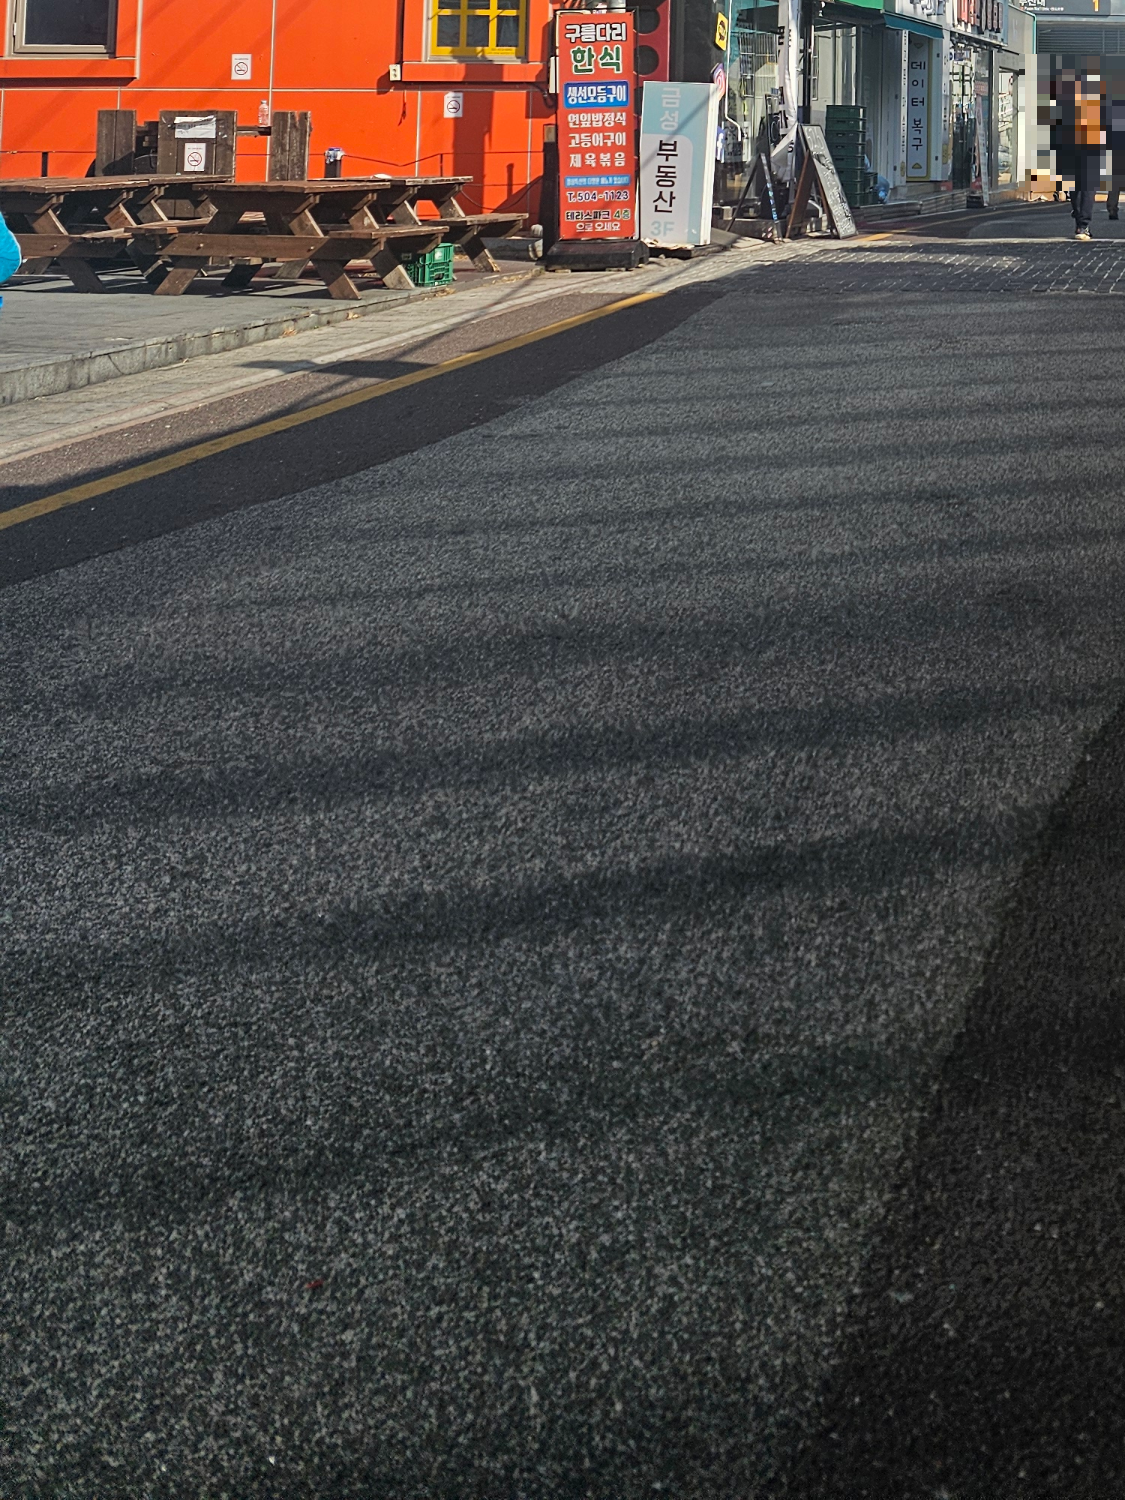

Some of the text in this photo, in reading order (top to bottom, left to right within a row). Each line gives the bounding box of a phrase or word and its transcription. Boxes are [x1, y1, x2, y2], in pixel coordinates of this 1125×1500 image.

[565, 23, 627, 43] 구름다리
[571, 45, 623, 74] 한식
[659, 86, 682, 131] 금성
[910, 61, 926, 151] 데이터 복구
[568, 111, 627, 128] 연잎밥정식
[568, 132, 626, 148] 고등어구이
[652, 139, 679, 214] 부동산
[594, 221, 621, 232] 오세요
